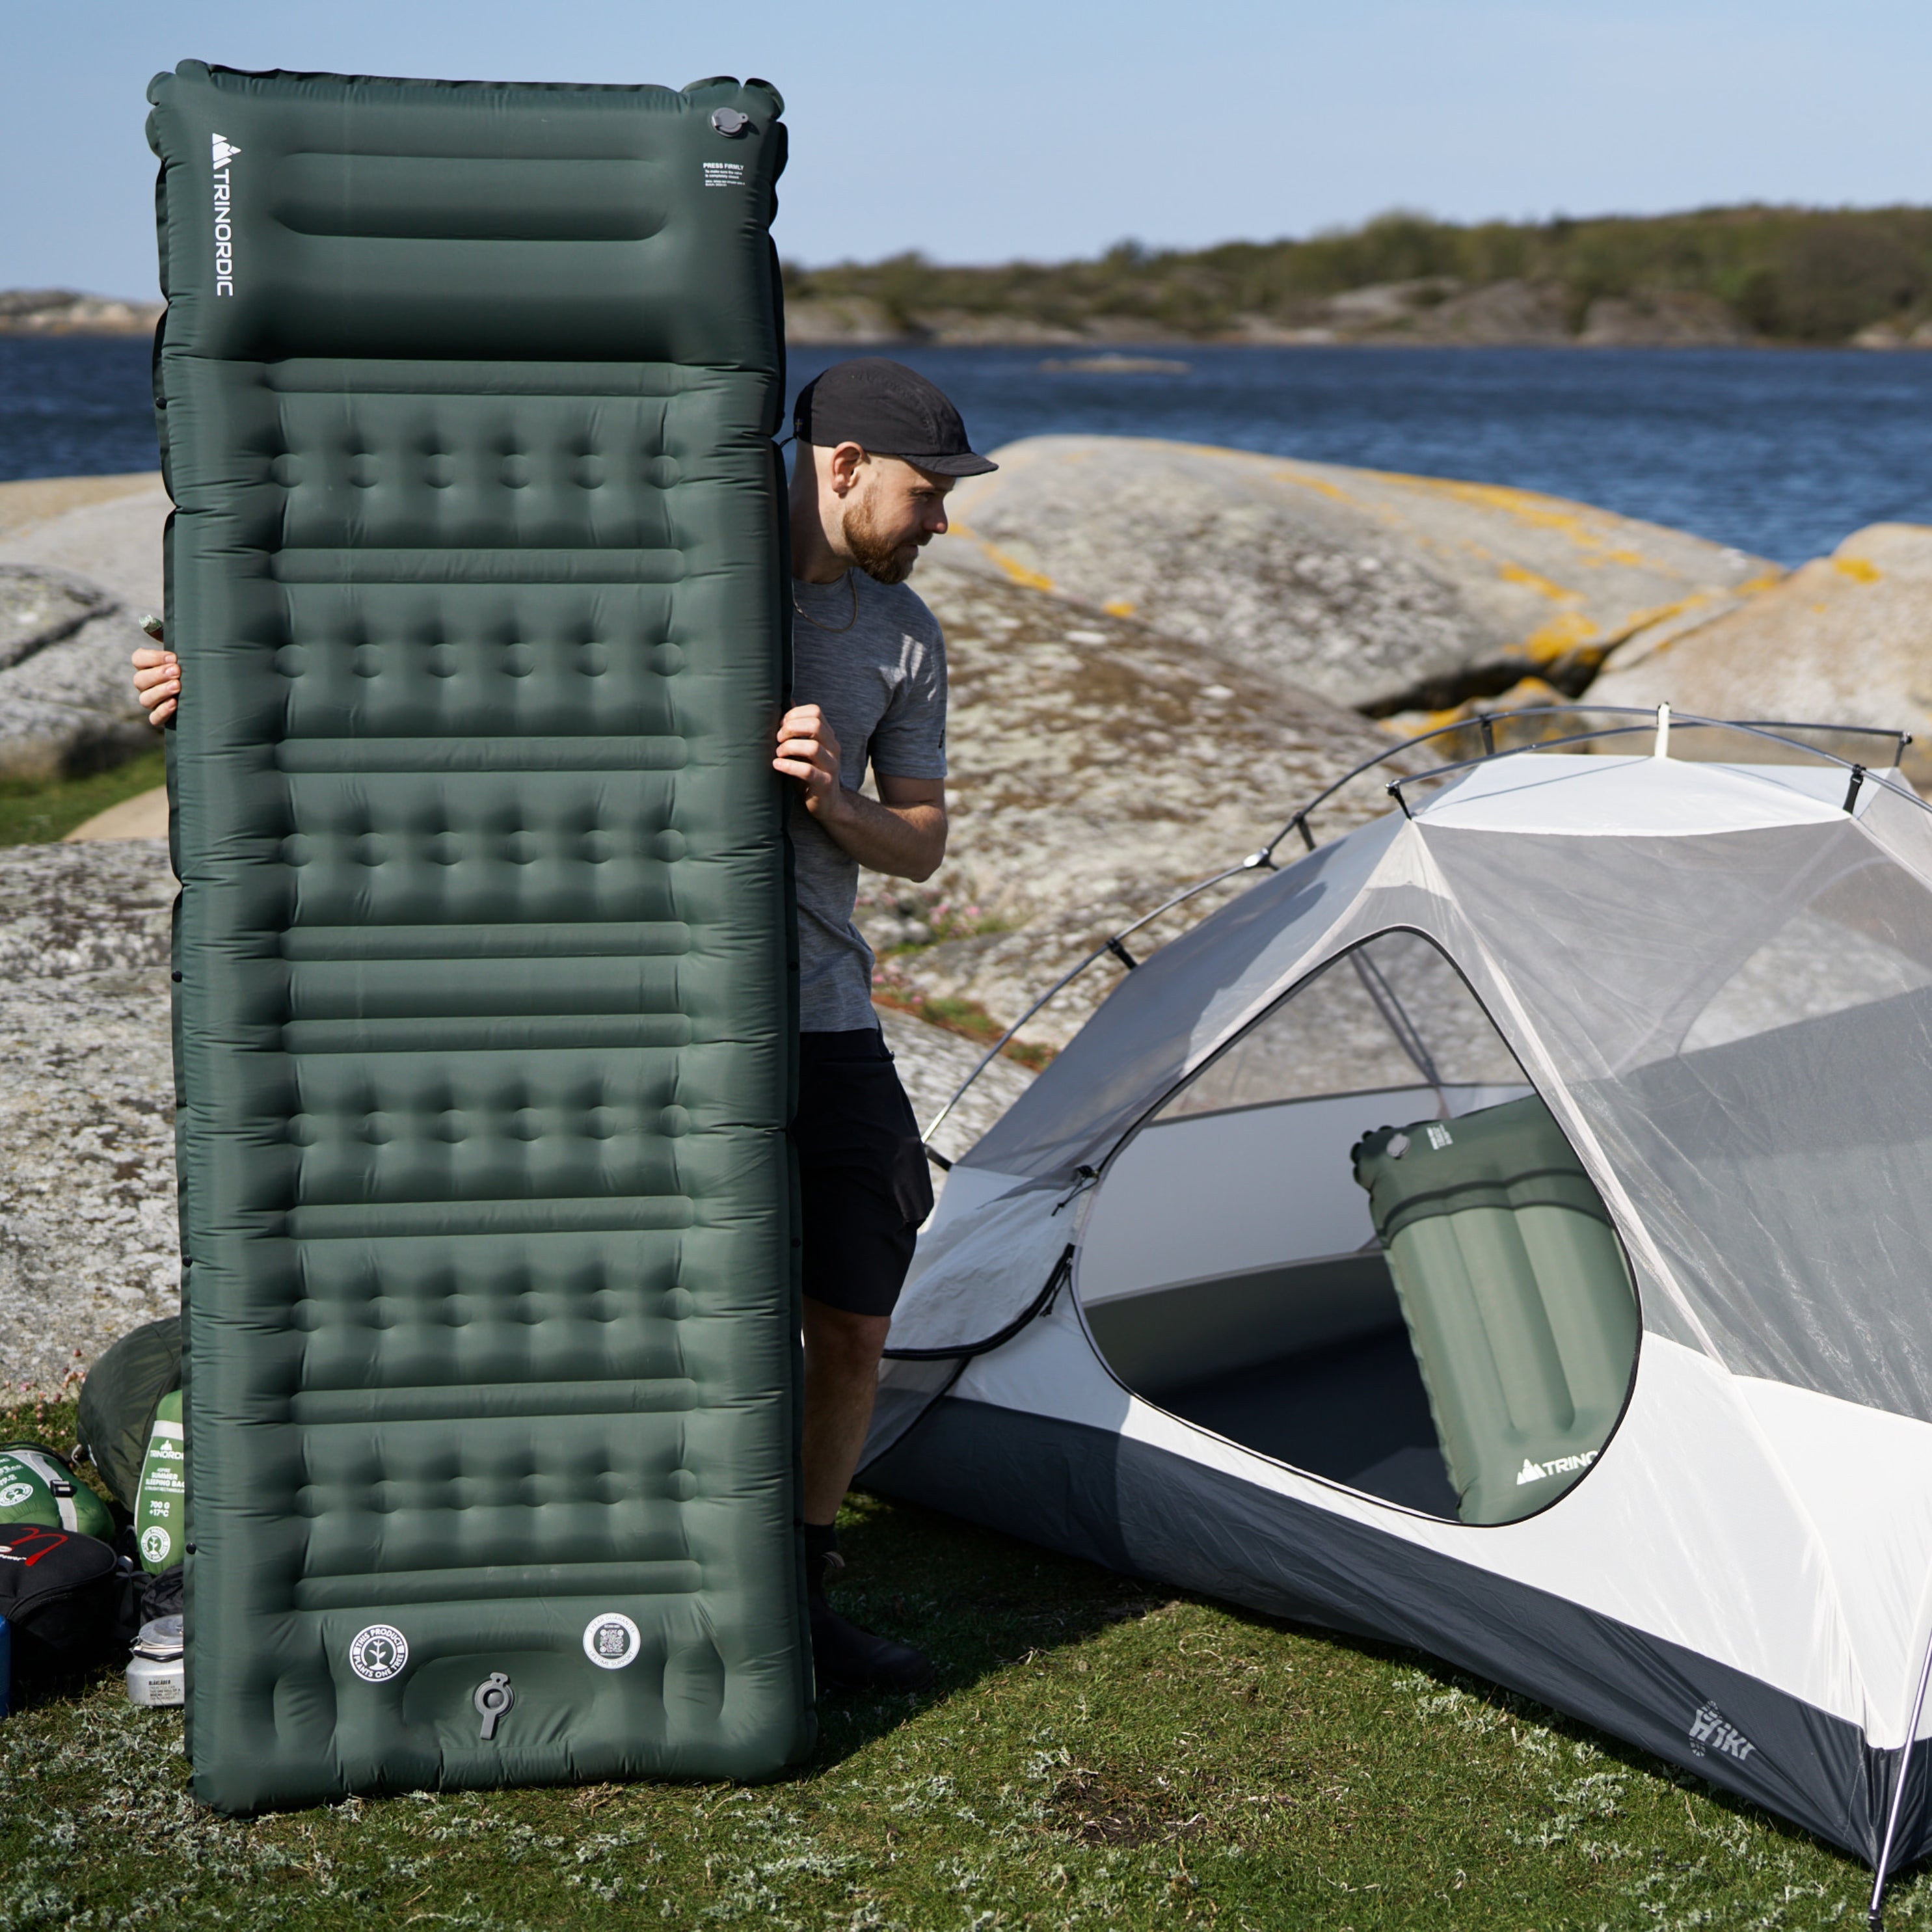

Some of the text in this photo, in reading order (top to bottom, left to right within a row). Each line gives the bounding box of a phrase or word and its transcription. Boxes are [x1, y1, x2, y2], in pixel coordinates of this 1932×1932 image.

[213, 168, 234, 296] TRINORDIC
[151, 1472, 178, 1481] SUMMER
[150, 1500, 163, 1509] 700
[355, 1628, 403, 1648] THIS PRODUCT
[354, 1654, 404, 1678] PLANTS ONE TREE
